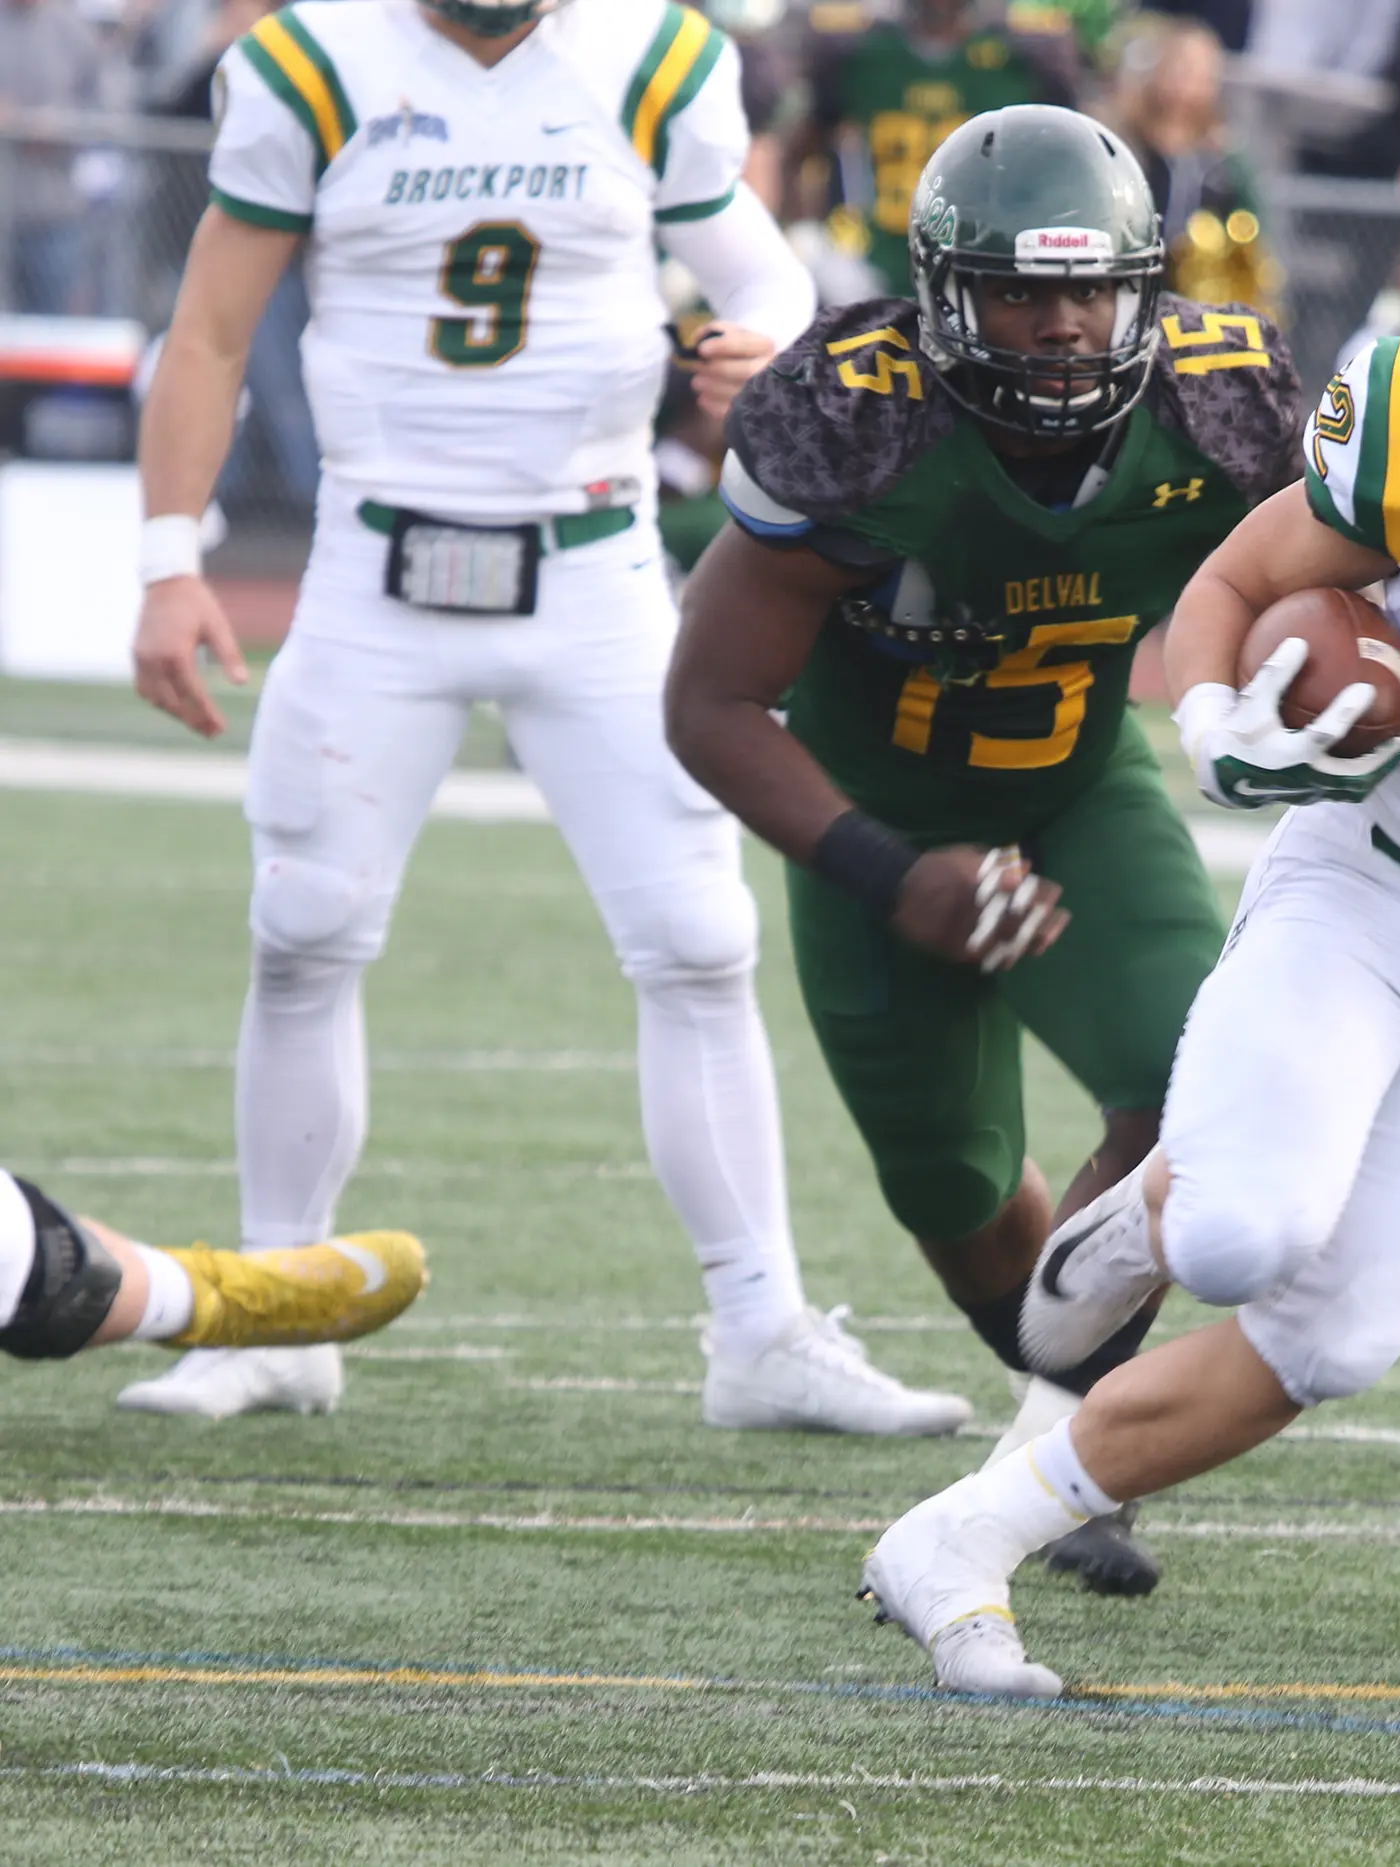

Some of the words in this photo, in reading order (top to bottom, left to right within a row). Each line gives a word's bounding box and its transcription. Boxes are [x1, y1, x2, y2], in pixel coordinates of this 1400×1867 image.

[384, 164, 588, 205] BROCKPORT
[1038, 231, 1089, 249] Riddell
[426, 219, 543, 369] 9
[1005, 572, 1102, 616] DELVAL
